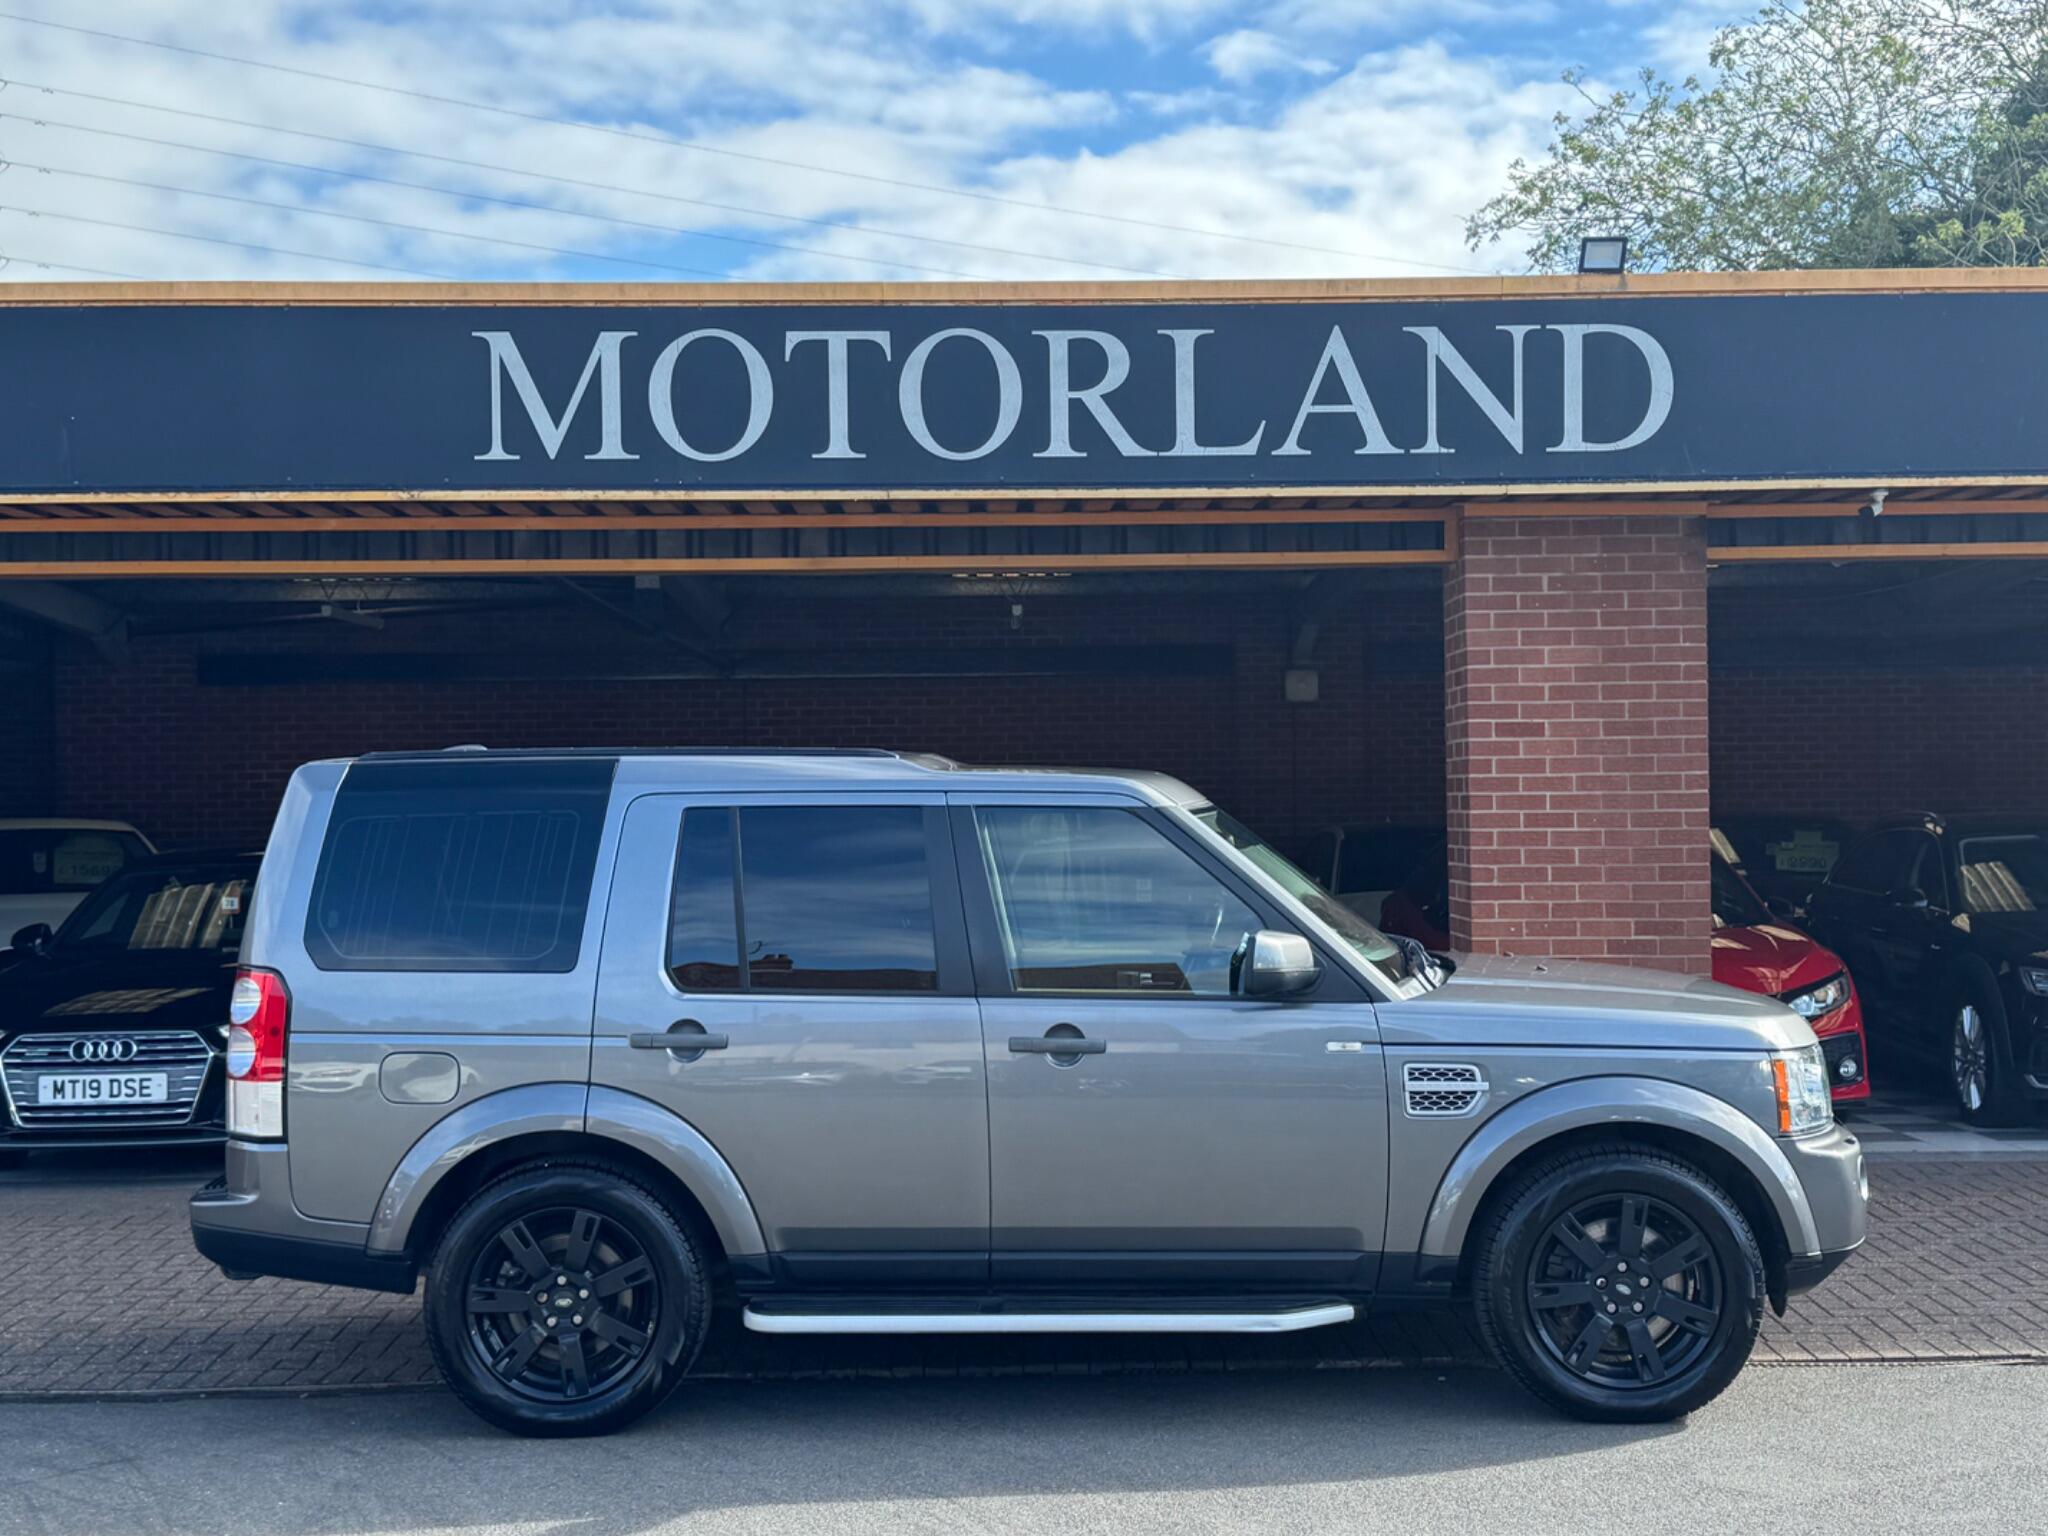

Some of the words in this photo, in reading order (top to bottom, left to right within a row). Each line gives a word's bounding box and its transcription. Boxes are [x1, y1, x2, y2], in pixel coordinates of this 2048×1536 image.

[471, 322, 1675, 463] MOTORLAND
[52, 1079, 101, 1100] MT19
[108, 1077, 153, 1099] DSE
